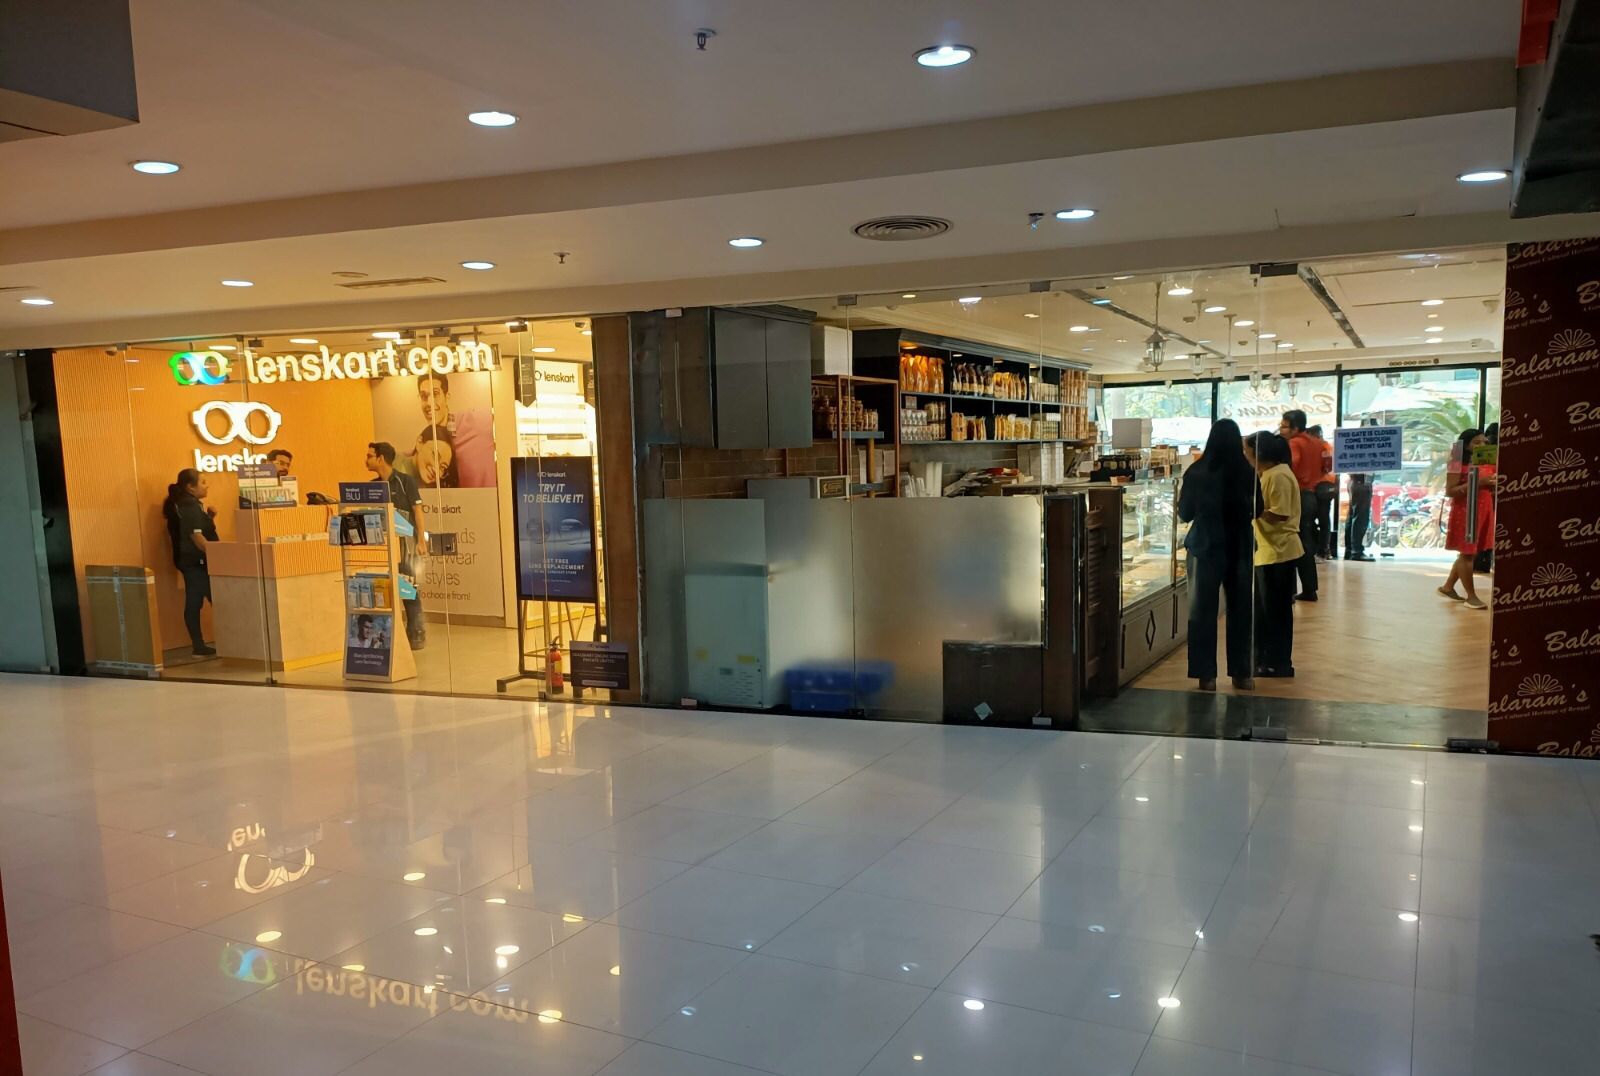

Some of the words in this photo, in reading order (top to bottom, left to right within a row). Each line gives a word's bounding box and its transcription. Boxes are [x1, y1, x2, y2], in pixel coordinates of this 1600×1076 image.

[244, 340, 496, 384] lenskart.com
[1502, 348, 1600, 380] Balaram
[543, 371, 575, 383] lenskart
[538, 483, 556, 493] TRY
[556, 483, 565, 493] IT
[522, 494, 535, 503] TO
[535, 494, 571, 503] BELIEVE
[431, 504, 462, 514] leskart
